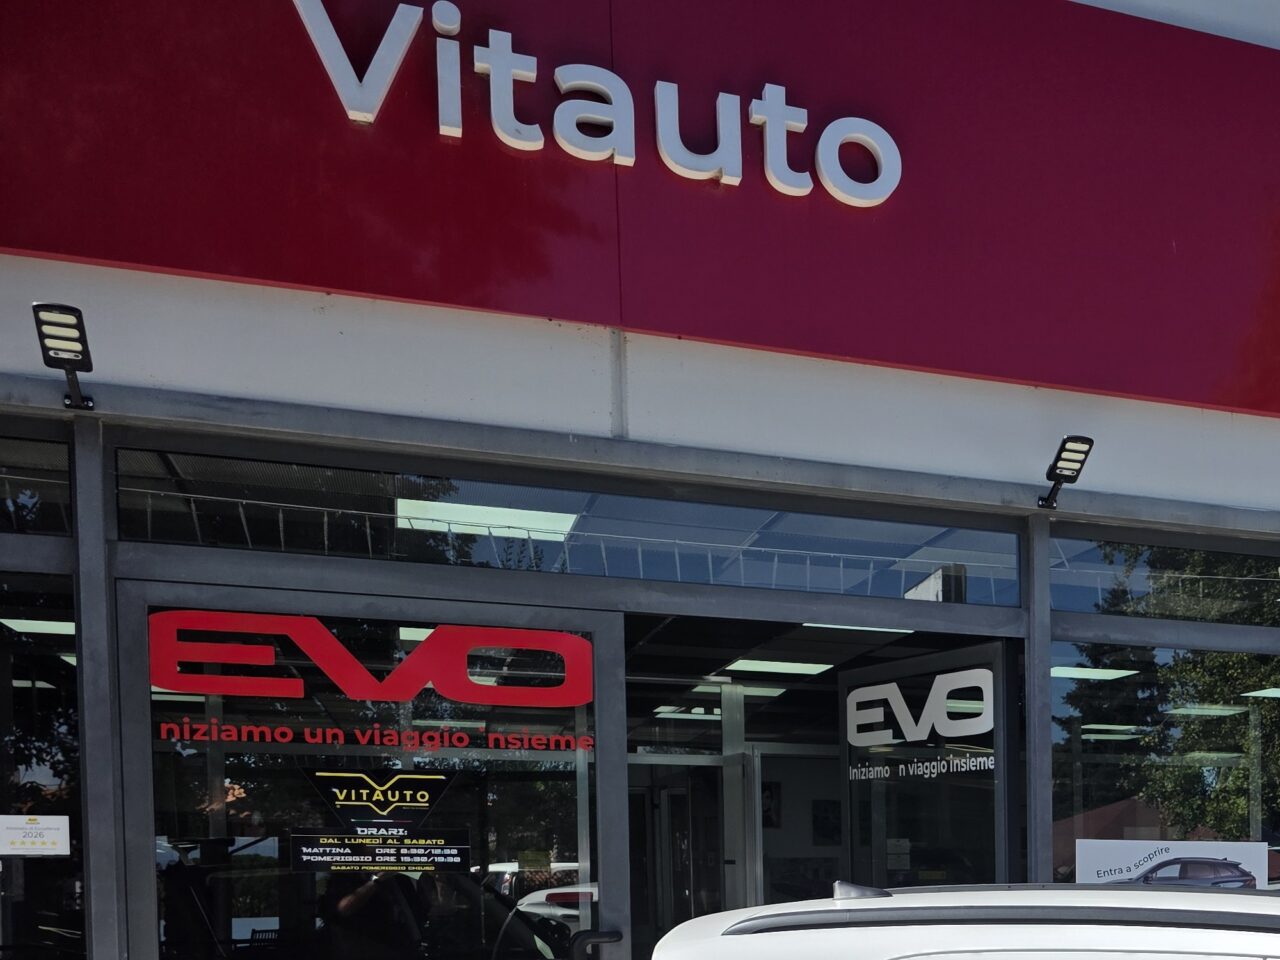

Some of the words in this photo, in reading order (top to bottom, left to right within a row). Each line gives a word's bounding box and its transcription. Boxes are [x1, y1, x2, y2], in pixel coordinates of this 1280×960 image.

[292, 0, 902, 208] Vitauto
[149, 610, 594, 708] EVO
[846, 668, 995, 747] EVO
[303, 724, 345, 745] un
[353, 722, 470, 752] viaggio
[849, 761, 891, 781] Iniziamo
[908, 755, 948, 779] viaggio
[949, 752, 995, 773] insieme
[332, 788, 430, 803] VITAUTO
[22, 831, 45, 839] 2026
[356, 827, 408, 836] ORARI:
[301, 847, 352, 855] MATTINA
[1096, 867, 1124, 879] Entra
[1126, 865, 1132, 874] a
[1133, 845, 1170, 871] scoprire
